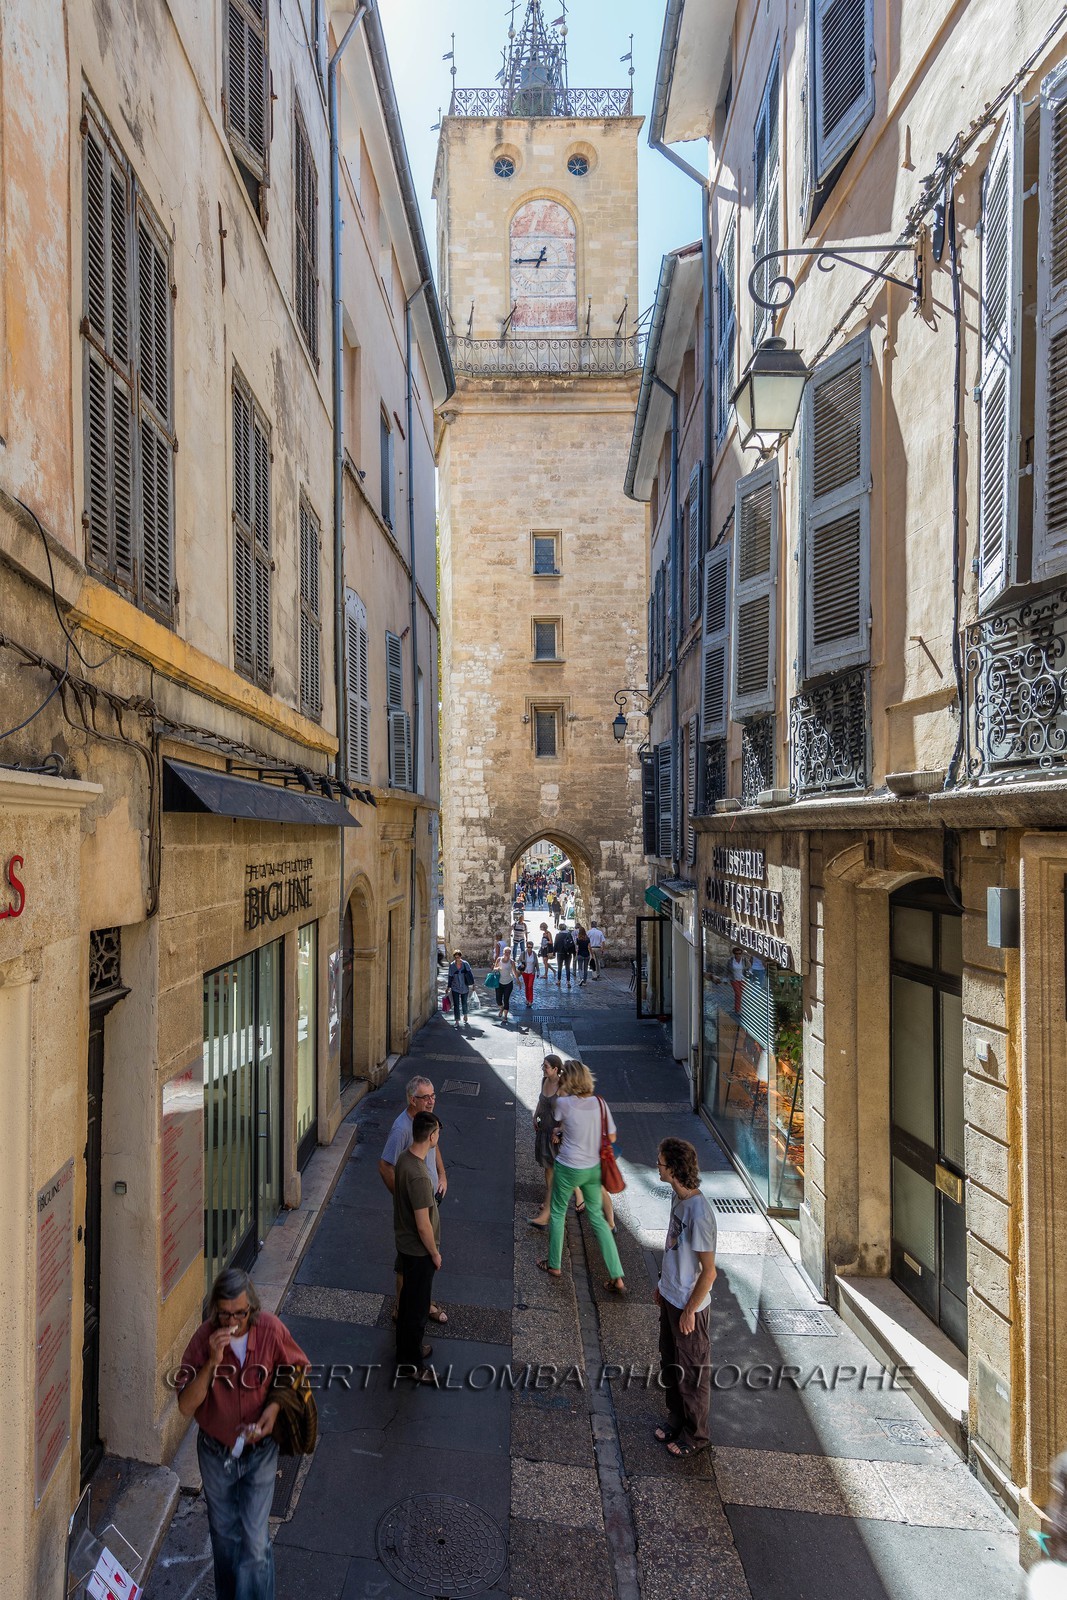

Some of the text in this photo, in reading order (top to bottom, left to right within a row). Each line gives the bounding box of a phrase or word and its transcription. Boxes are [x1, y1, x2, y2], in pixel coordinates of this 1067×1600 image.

[245, 874, 313, 930] BIGUINE
[707, 877, 780, 925] CONFISERIE
[739, 926, 789, 969] CALISSONS
